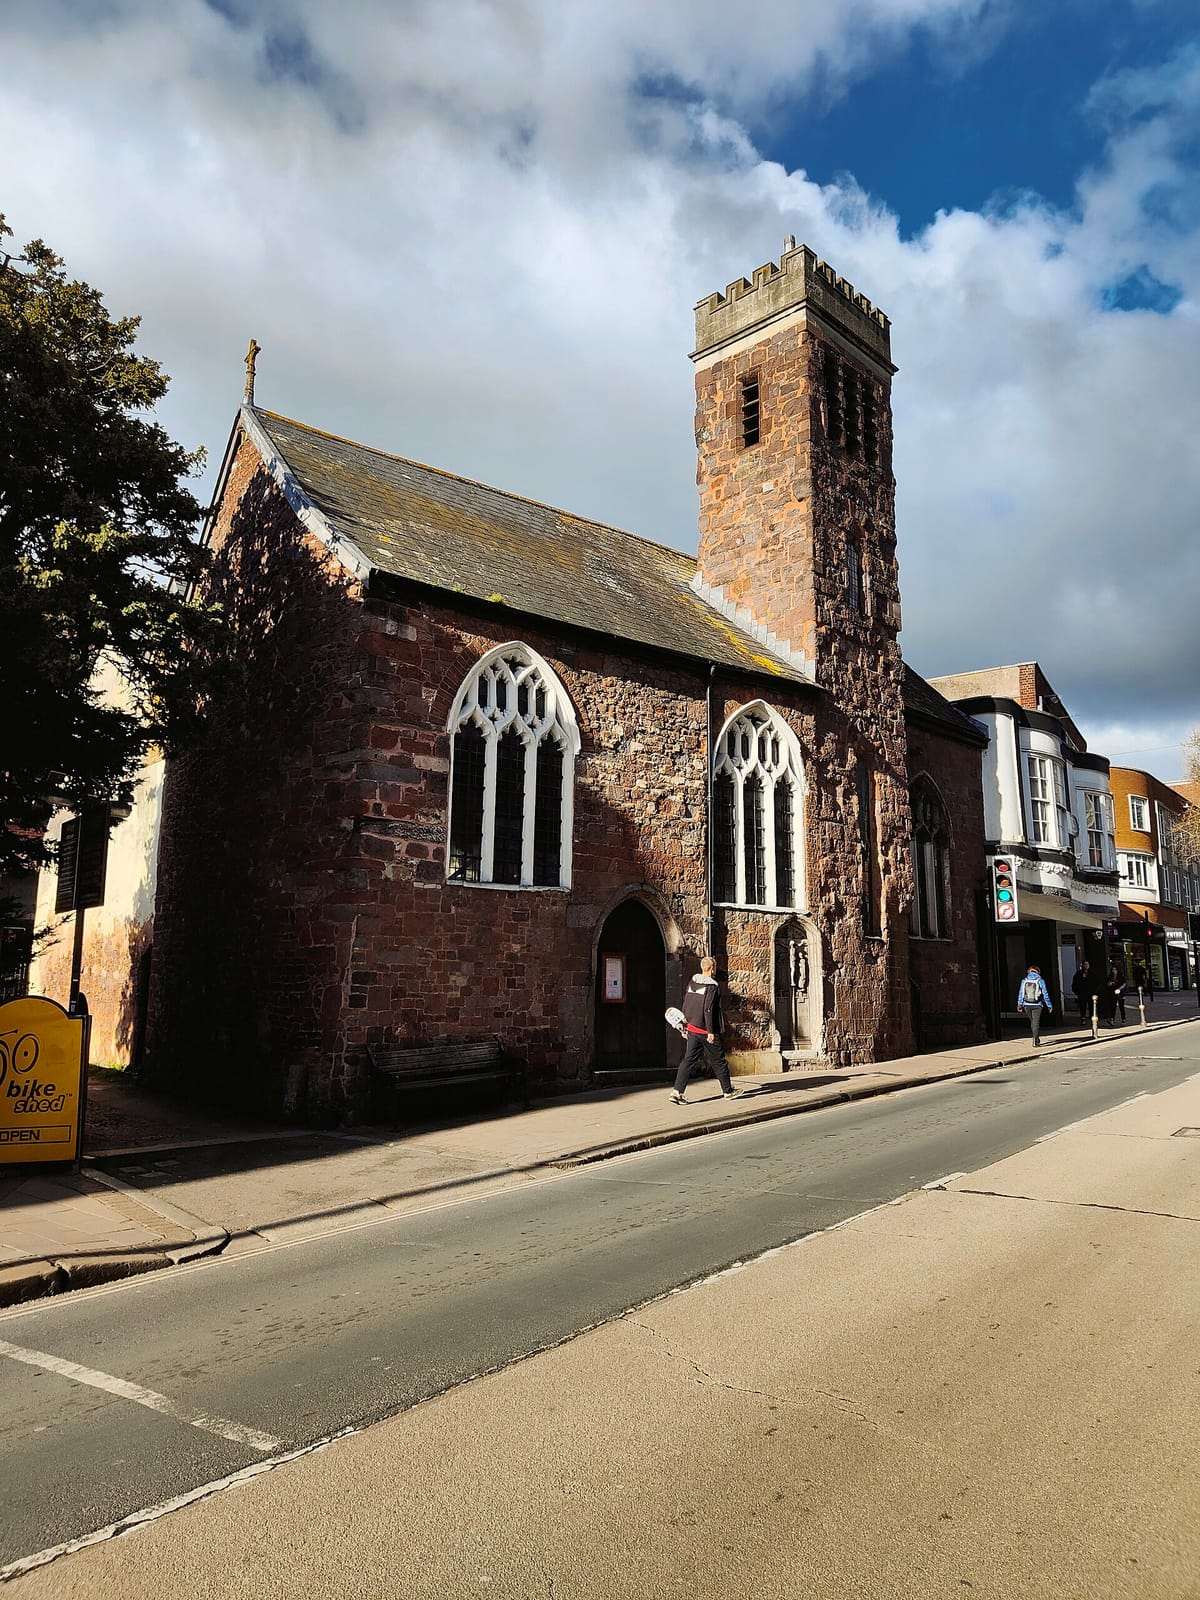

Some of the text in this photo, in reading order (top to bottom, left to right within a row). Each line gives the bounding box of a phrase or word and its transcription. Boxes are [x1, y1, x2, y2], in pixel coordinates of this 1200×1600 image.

[6, 1079, 56, 1097] bike
[14, 1094, 65, 1113] shed
[0, 1130, 40, 1142] OPEN
